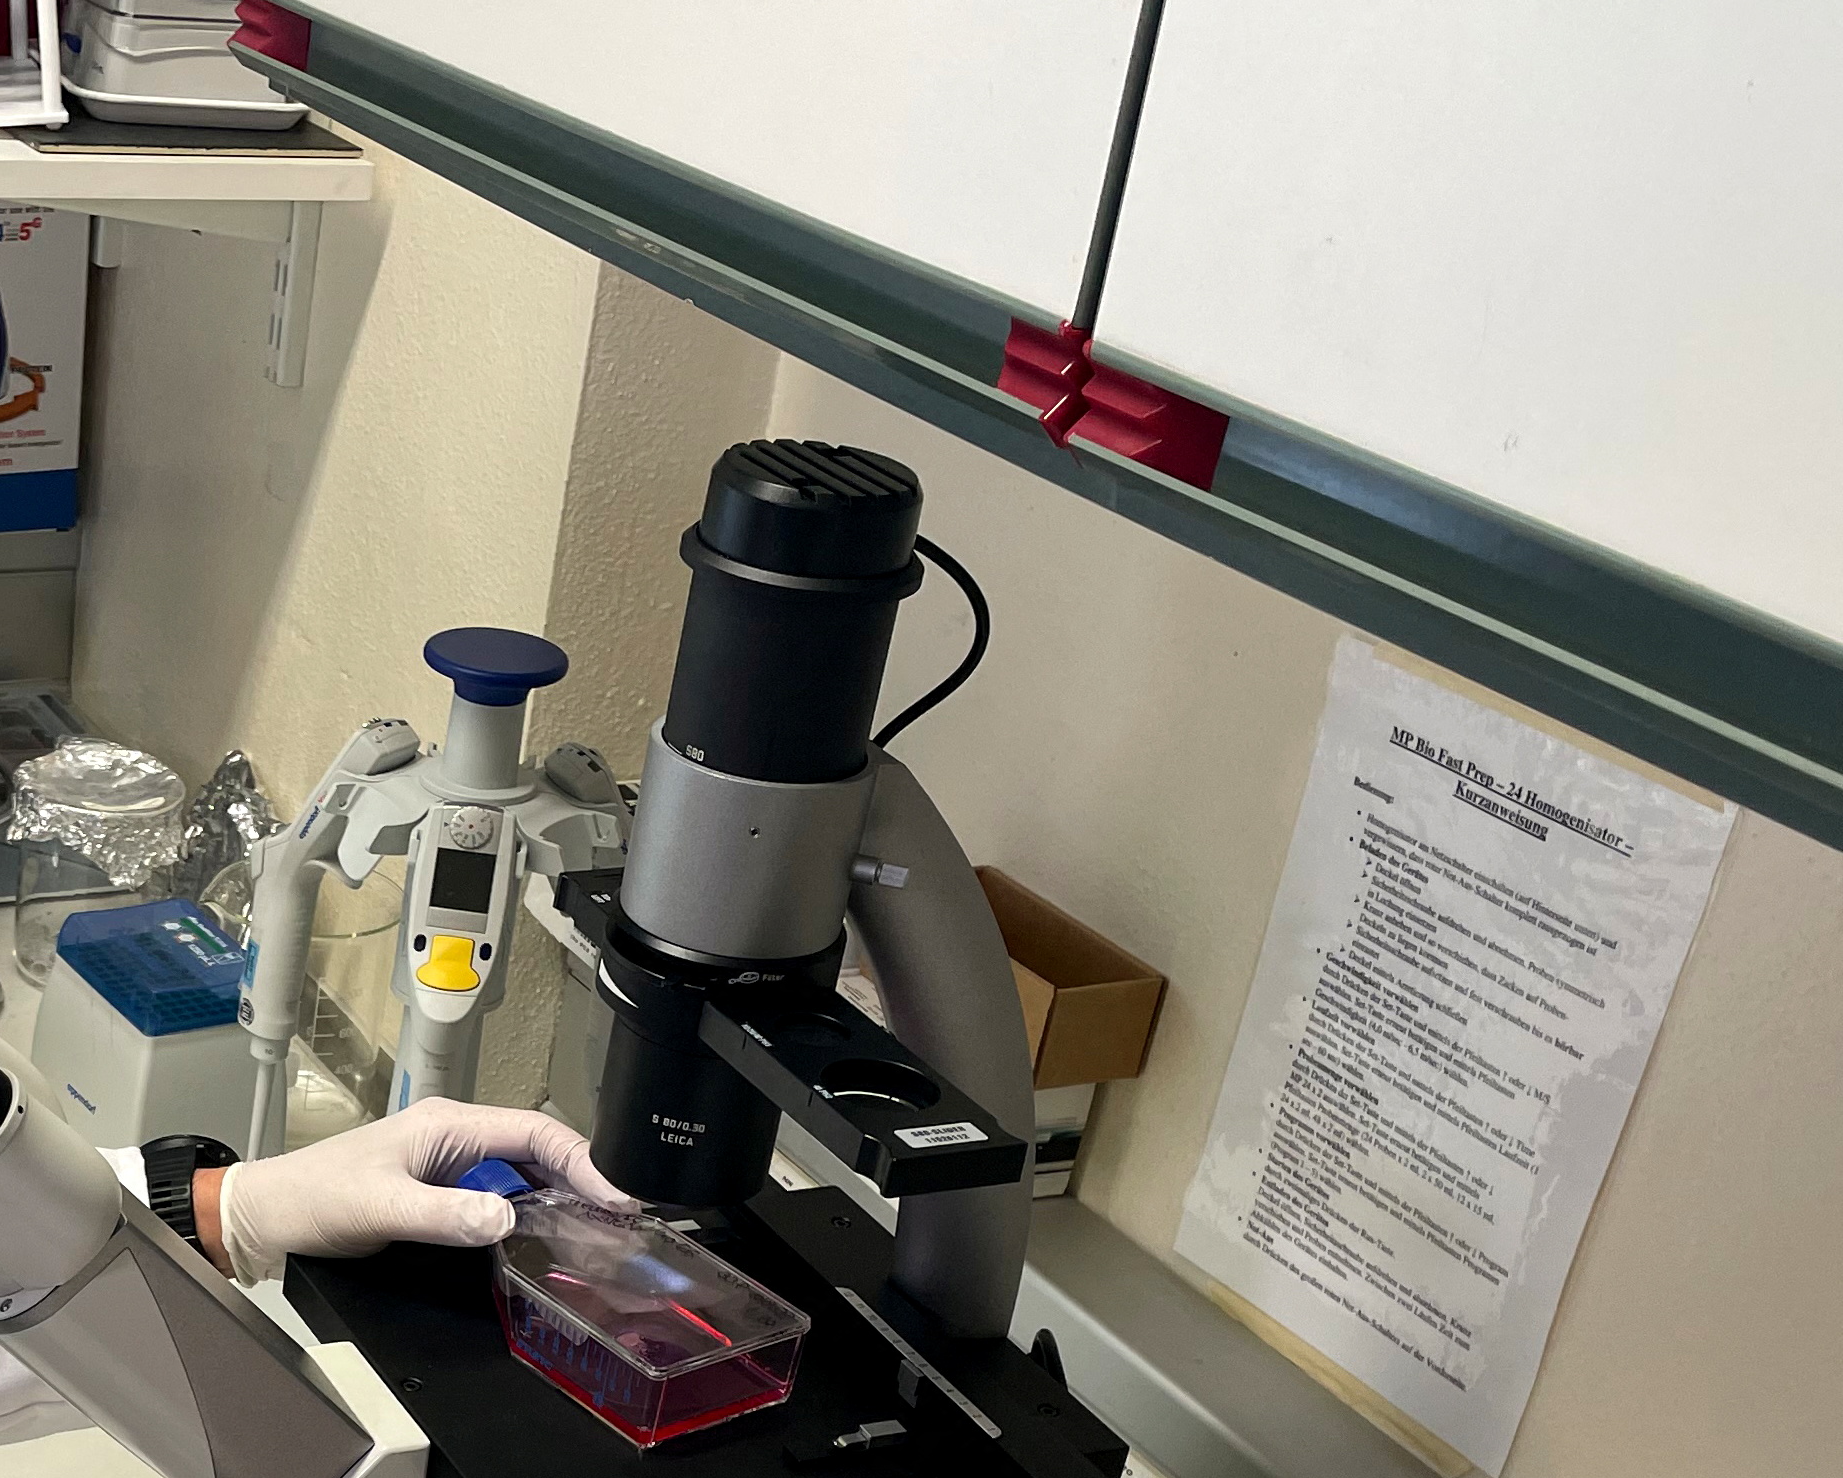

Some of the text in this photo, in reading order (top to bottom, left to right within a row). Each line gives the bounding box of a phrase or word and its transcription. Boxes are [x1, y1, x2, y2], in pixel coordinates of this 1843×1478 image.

[685, 744, 705, 762] S80
[1390, 726, 1414, 748] MP
[1414, 737, 1437, 759] Bio
[1436, 747, 1464, 772] Fast
[1463, 761, 1496, 790] Prep
[1506, 780, 1523, 800] 24
[1523, 788, 1625, 850] Homogenisator
[1454, 780, 1550, 840] Kurzanweisung
[660, 1131, 694, 1147] LEICA
